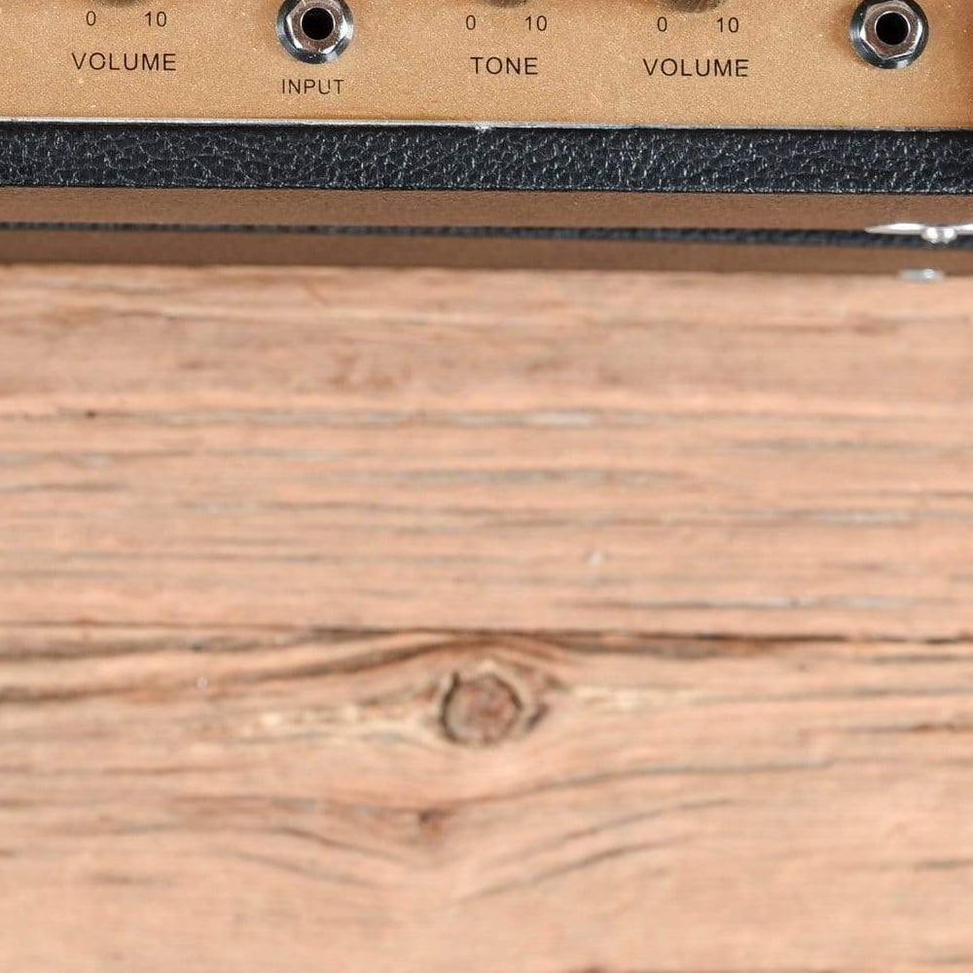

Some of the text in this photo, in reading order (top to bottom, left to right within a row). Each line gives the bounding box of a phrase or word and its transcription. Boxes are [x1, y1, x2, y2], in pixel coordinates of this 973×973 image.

[86, 10, 97, 27] 0
[144, 11, 167, 27] 10
[465, 14, 476, 31] 0
[525, 15, 548, 32] 10
[656, 16, 668, 33] 0
[716, 16, 739, 33] 10
[72, 52, 177, 71] VOLUME
[470, 57, 539, 75] TONE
[643, 58, 749, 77] VOLUME
[281, 79, 344, 94] INPUT
